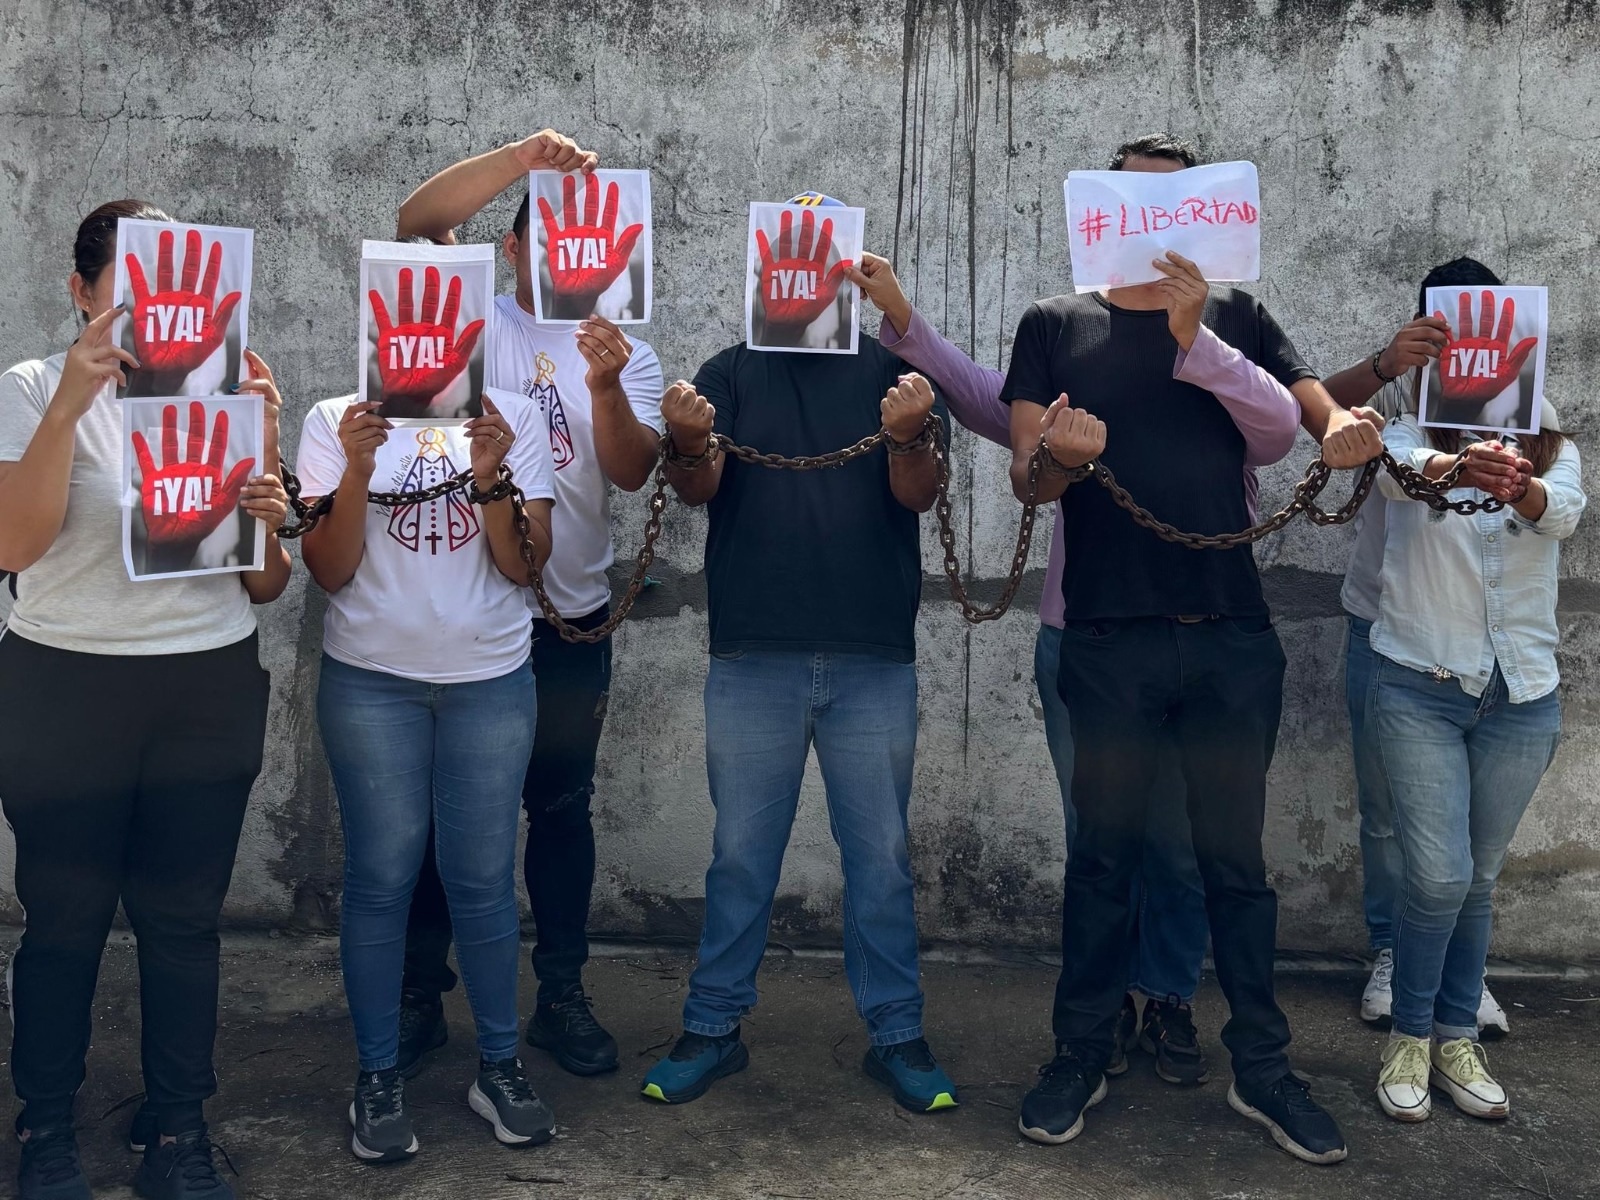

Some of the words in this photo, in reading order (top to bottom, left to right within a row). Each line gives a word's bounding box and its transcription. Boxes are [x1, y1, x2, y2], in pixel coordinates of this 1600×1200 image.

[557, 237, 607, 271] ¡YA!
[770, 269, 817, 300] ¡YA!
[145, 304, 203, 343] ¡YA!
[388, 335, 446, 370] ¡YA!
[1448, 348, 1500, 378] ¡YA!
[391, 470, 406, 487] del
[400, 453, 413, 471] valle
[153, 476, 214, 516] ¡YA!
